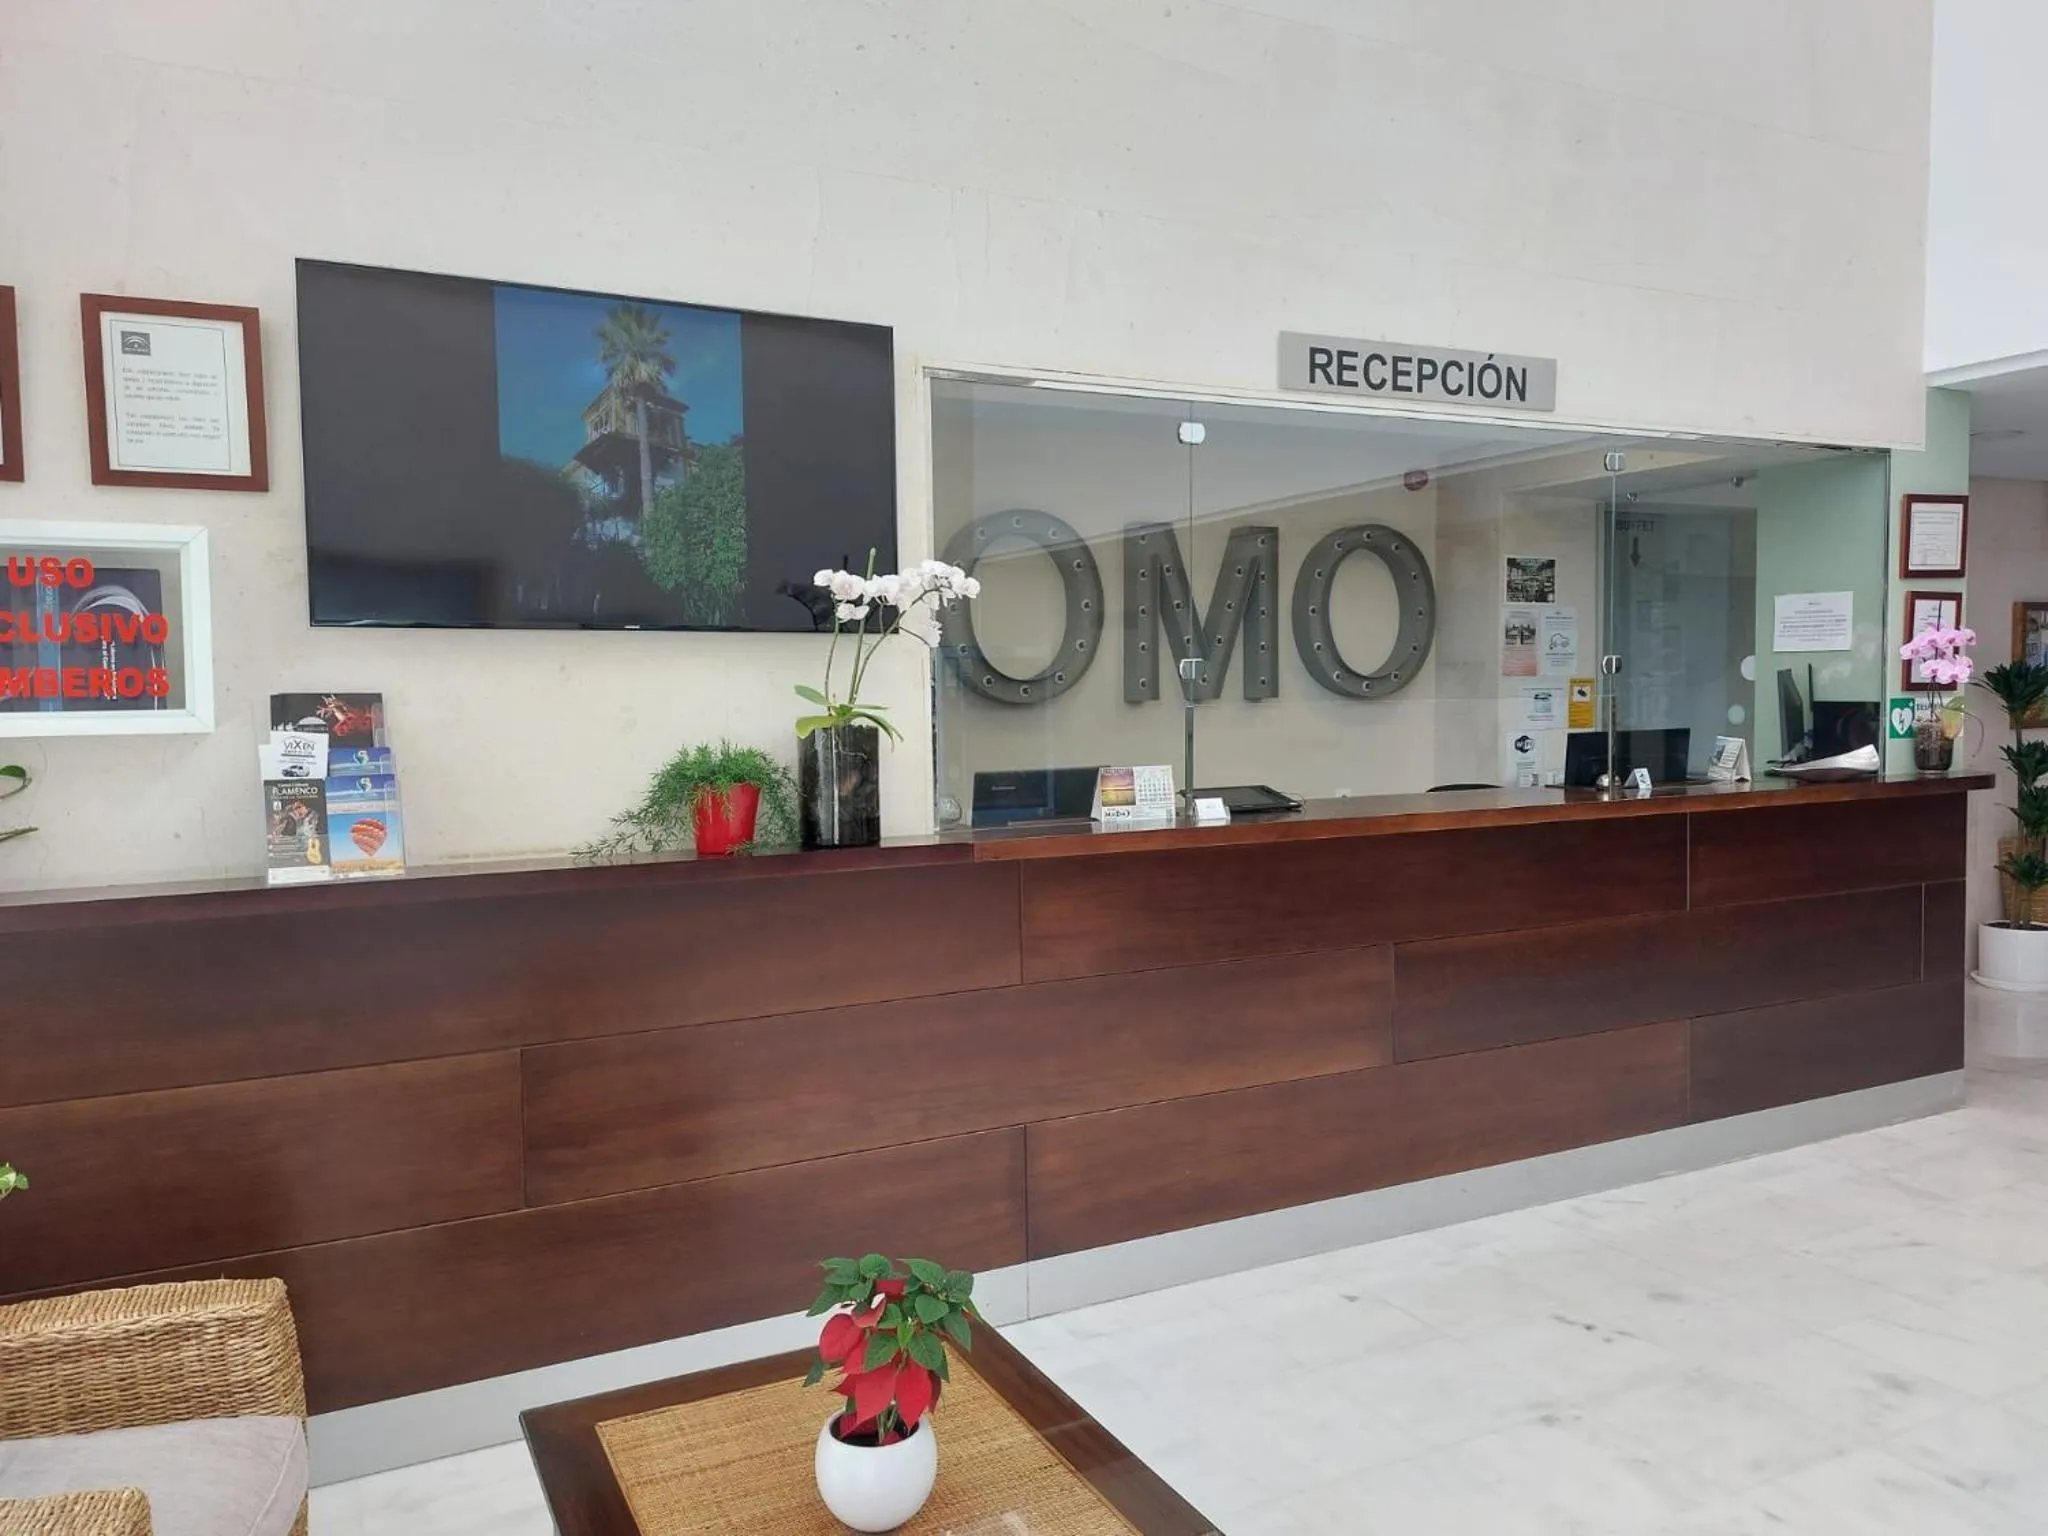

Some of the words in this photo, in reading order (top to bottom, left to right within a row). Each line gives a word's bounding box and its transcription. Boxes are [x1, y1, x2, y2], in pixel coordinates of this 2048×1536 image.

[1308, 346, 1527, 402] RECEPCIÓN
[8, 556, 95, 588] USO
[937, 509, 1436, 704] OMO
[283, 739, 316, 751] VIXEN
[272, 786, 319, 796] FLAMENCO
